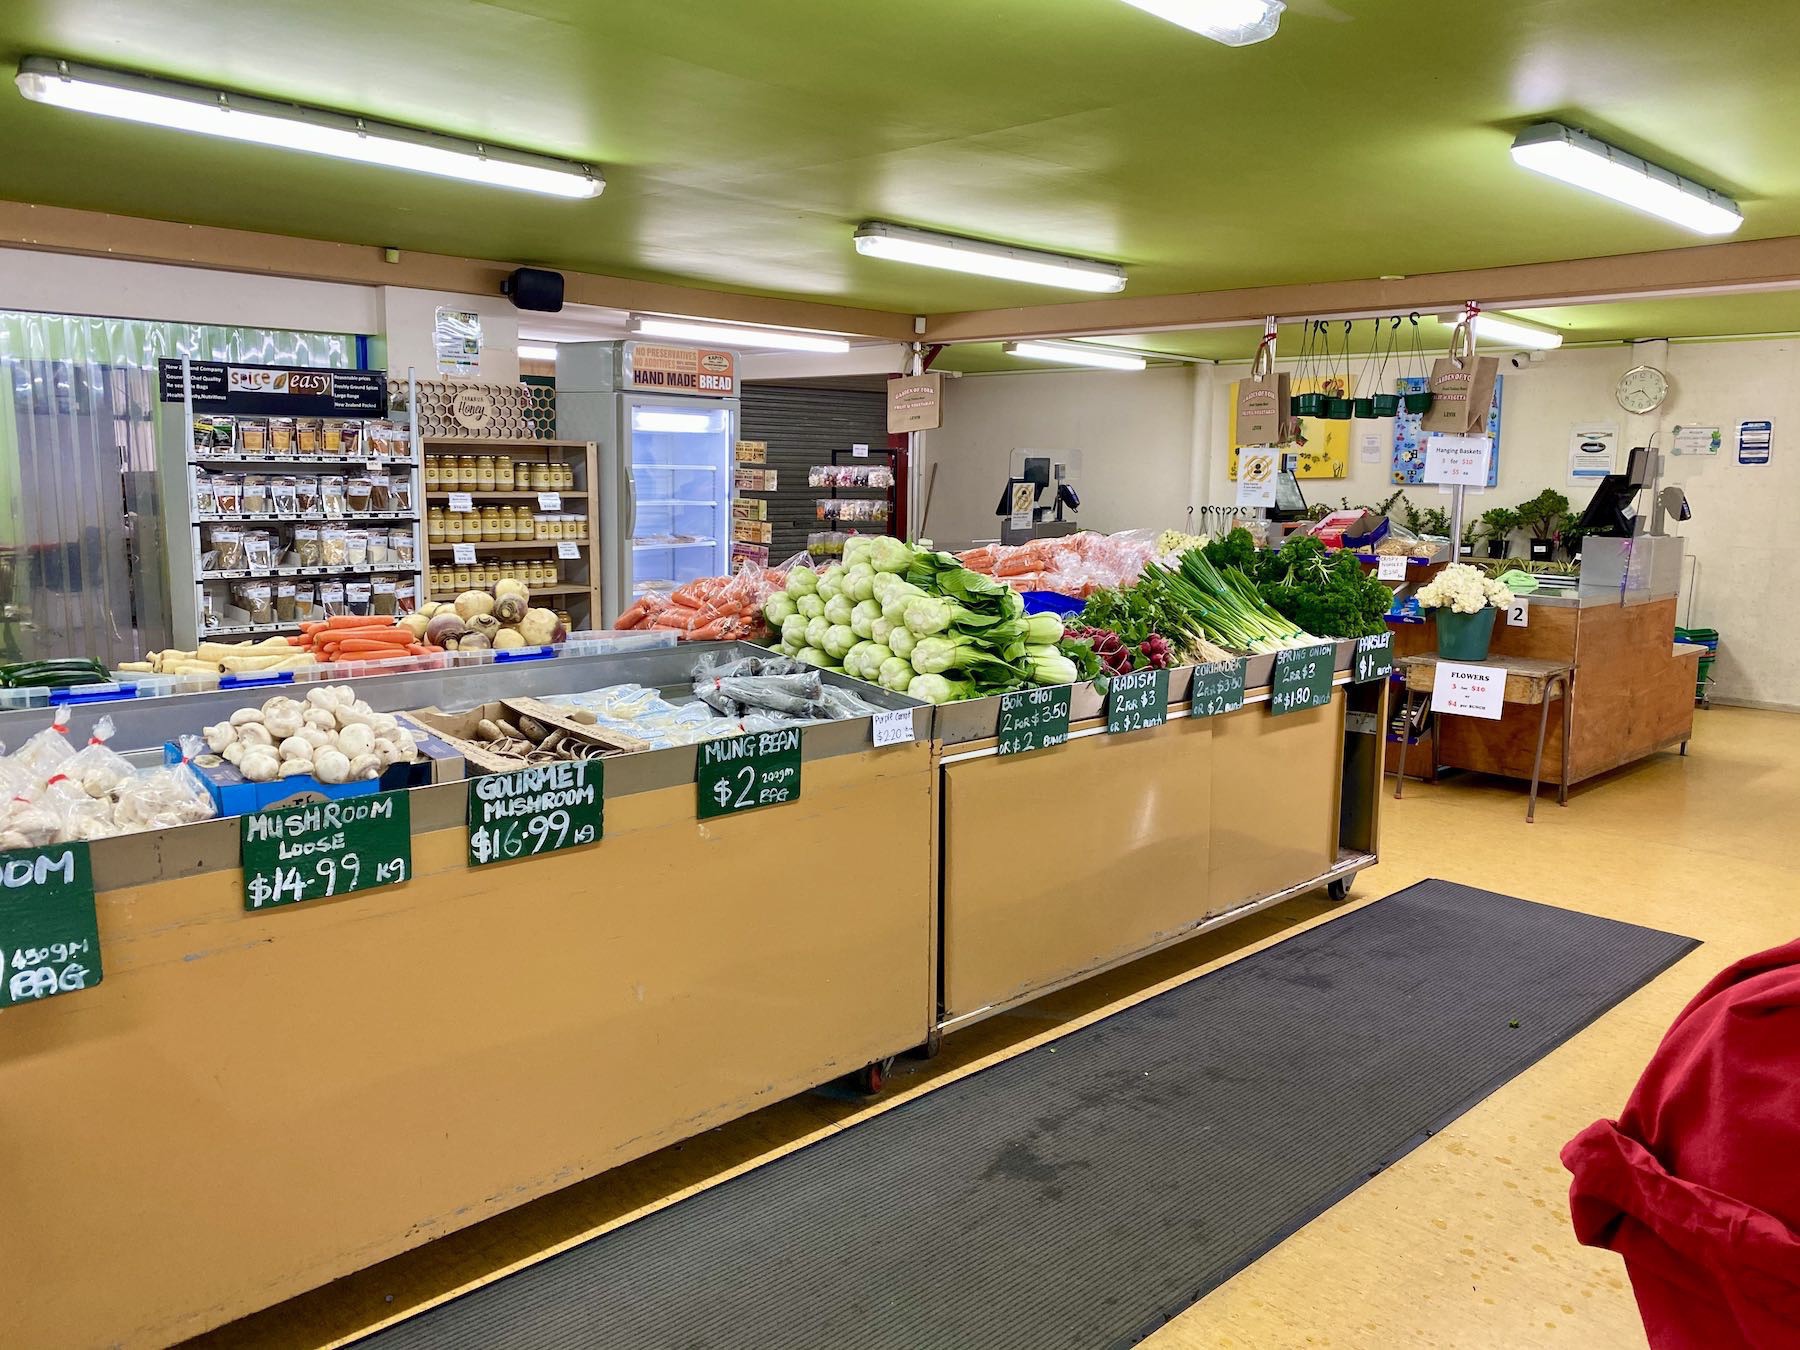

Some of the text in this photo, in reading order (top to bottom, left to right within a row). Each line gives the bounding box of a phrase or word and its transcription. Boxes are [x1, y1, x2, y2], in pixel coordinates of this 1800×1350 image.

[634, 357, 644, 367] NO
[645, 358, 675, 369] ADDITIVES
[635, 347, 696, 360] NO PRESERVATIVES
[290, 373, 330, 396] easy
[634, 370, 732, 390] HAND MADE BREAD
[458, 401, 487, 421] Honey
[1460, 447, 1482, 455] Baskets
[1513, 607, 1523, 622] 2
[1358, 632, 1391, 653] PARSLEY
[1277, 645, 1332, 664] SPRING ONION
[1195, 659, 1242, 677] CORIANDER
[1282, 662, 1316, 683] 2 FOR $3
[1451, 671, 1490, 682] FLOWERS
[1112, 674, 1157, 694] RADISH
[1197, 681, 1205, 697] 2
[1002, 689, 1053, 712] BOK CHOI
[1116, 690, 1156, 713] 2 FOR $3
[1207, 696, 1223, 716] $2
[1273, 693, 1283, 705] OR
[875, 711, 911, 724] Purple Carrot
[1003, 713, 1012, 732] 2
[1015, 719, 1030, 730] FOR
[1110, 722, 1120, 732] OR
[1124, 713, 1142, 731] $2
[704, 727, 800, 766] MUNG BEAN
[999, 742, 1011, 754] OR
[1012, 732, 1035, 753] $2
[476, 761, 588, 801] GOURMET
[713, 765, 756, 809] $2
[483, 783, 595, 823] MUSHROOM
[759, 787, 790, 804] BAG
[246, 796, 394, 842] MUSHROOM
[278, 831, 347, 861] LOOSE
[471, 809, 571, 864] $16.99
[9, 962, 91, 1002] BAG
